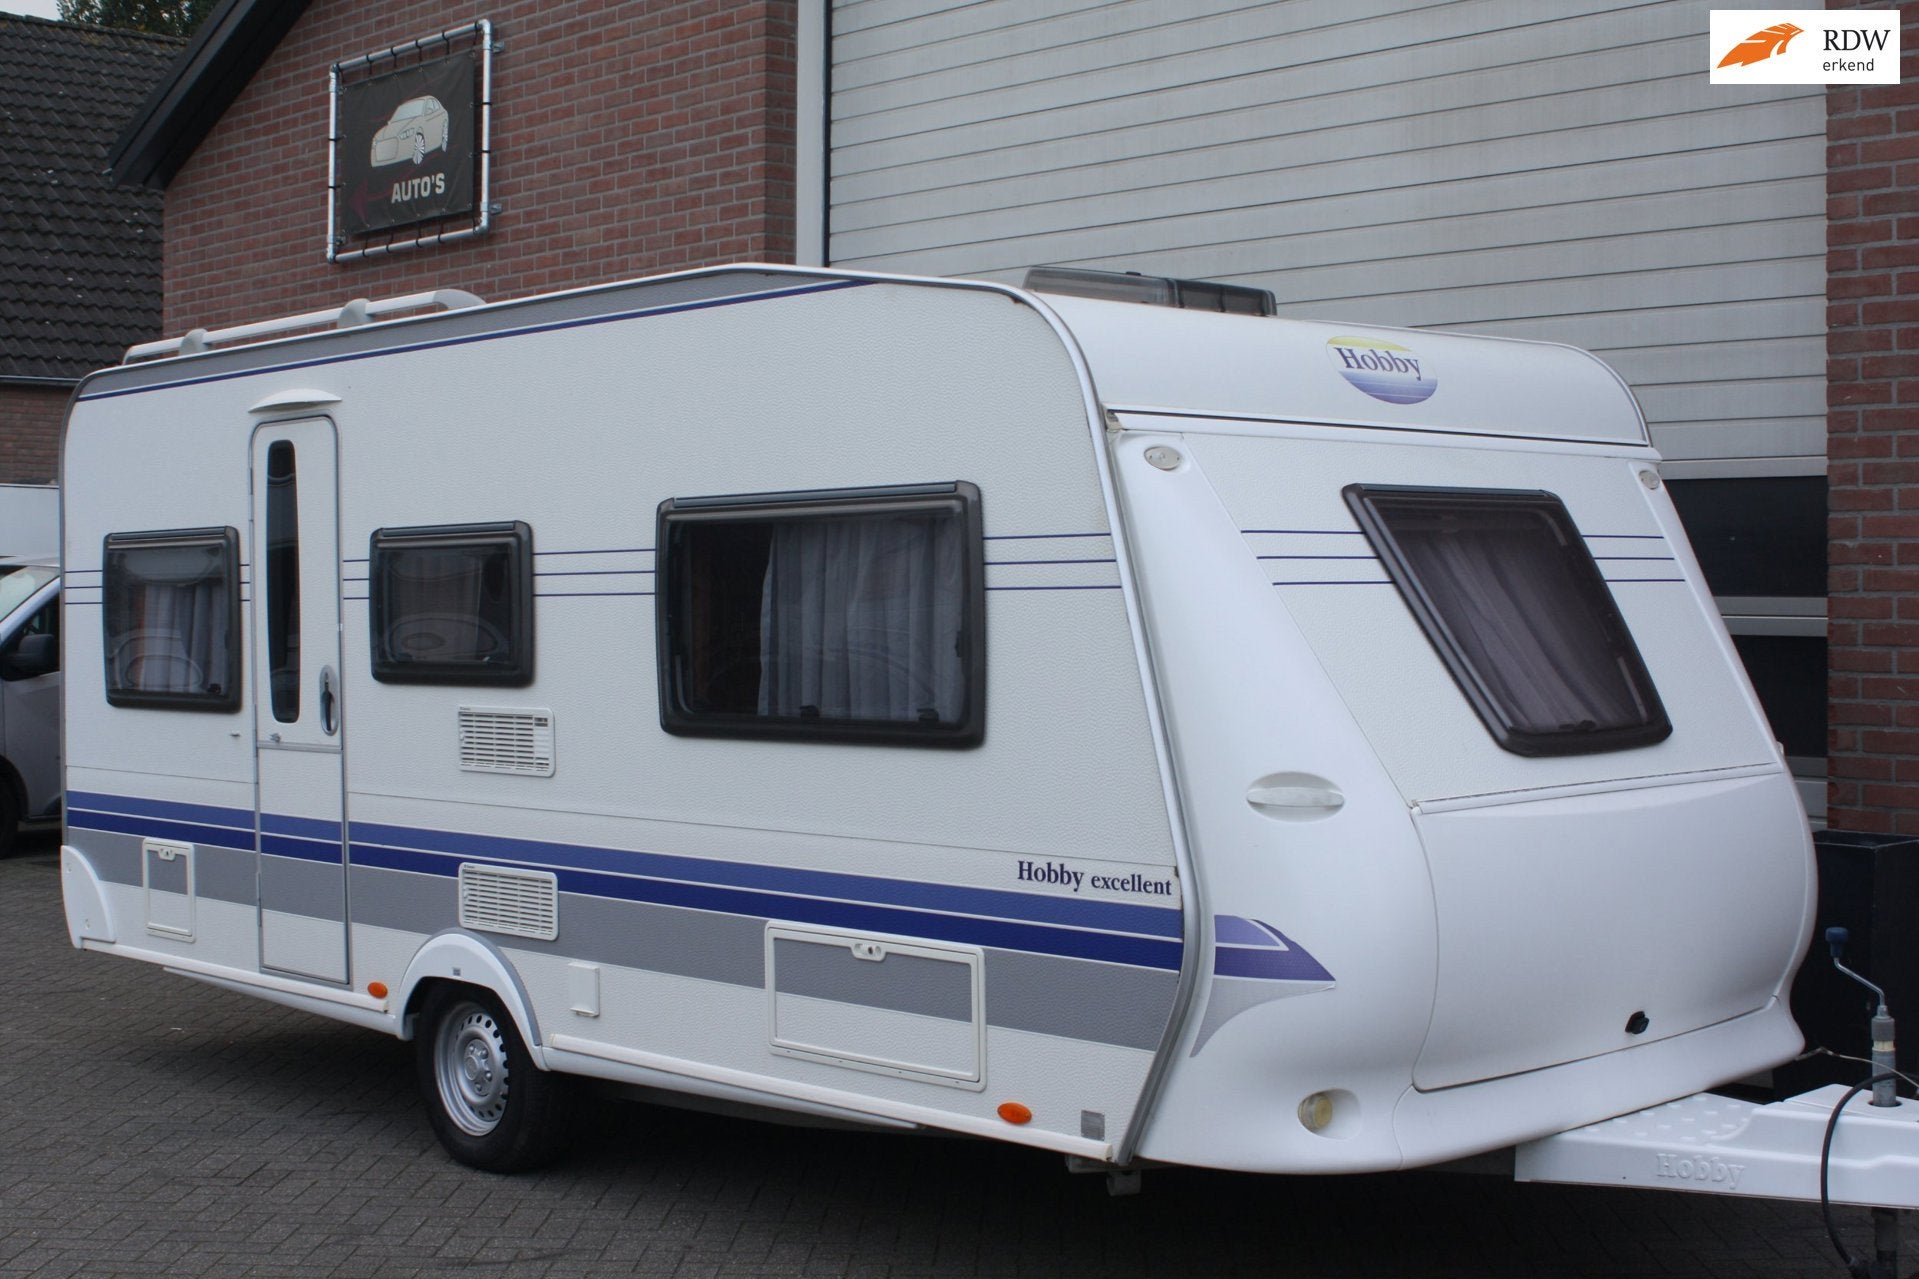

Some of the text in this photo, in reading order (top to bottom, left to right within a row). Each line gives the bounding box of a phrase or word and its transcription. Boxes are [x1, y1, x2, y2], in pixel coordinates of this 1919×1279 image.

[391, 172, 445, 204] AUTO'S
[1333, 346, 1422, 382] Hobby
[1017, 860, 1172, 896] Hobby excellent
[1656, 1152, 1746, 1191] Hobby
